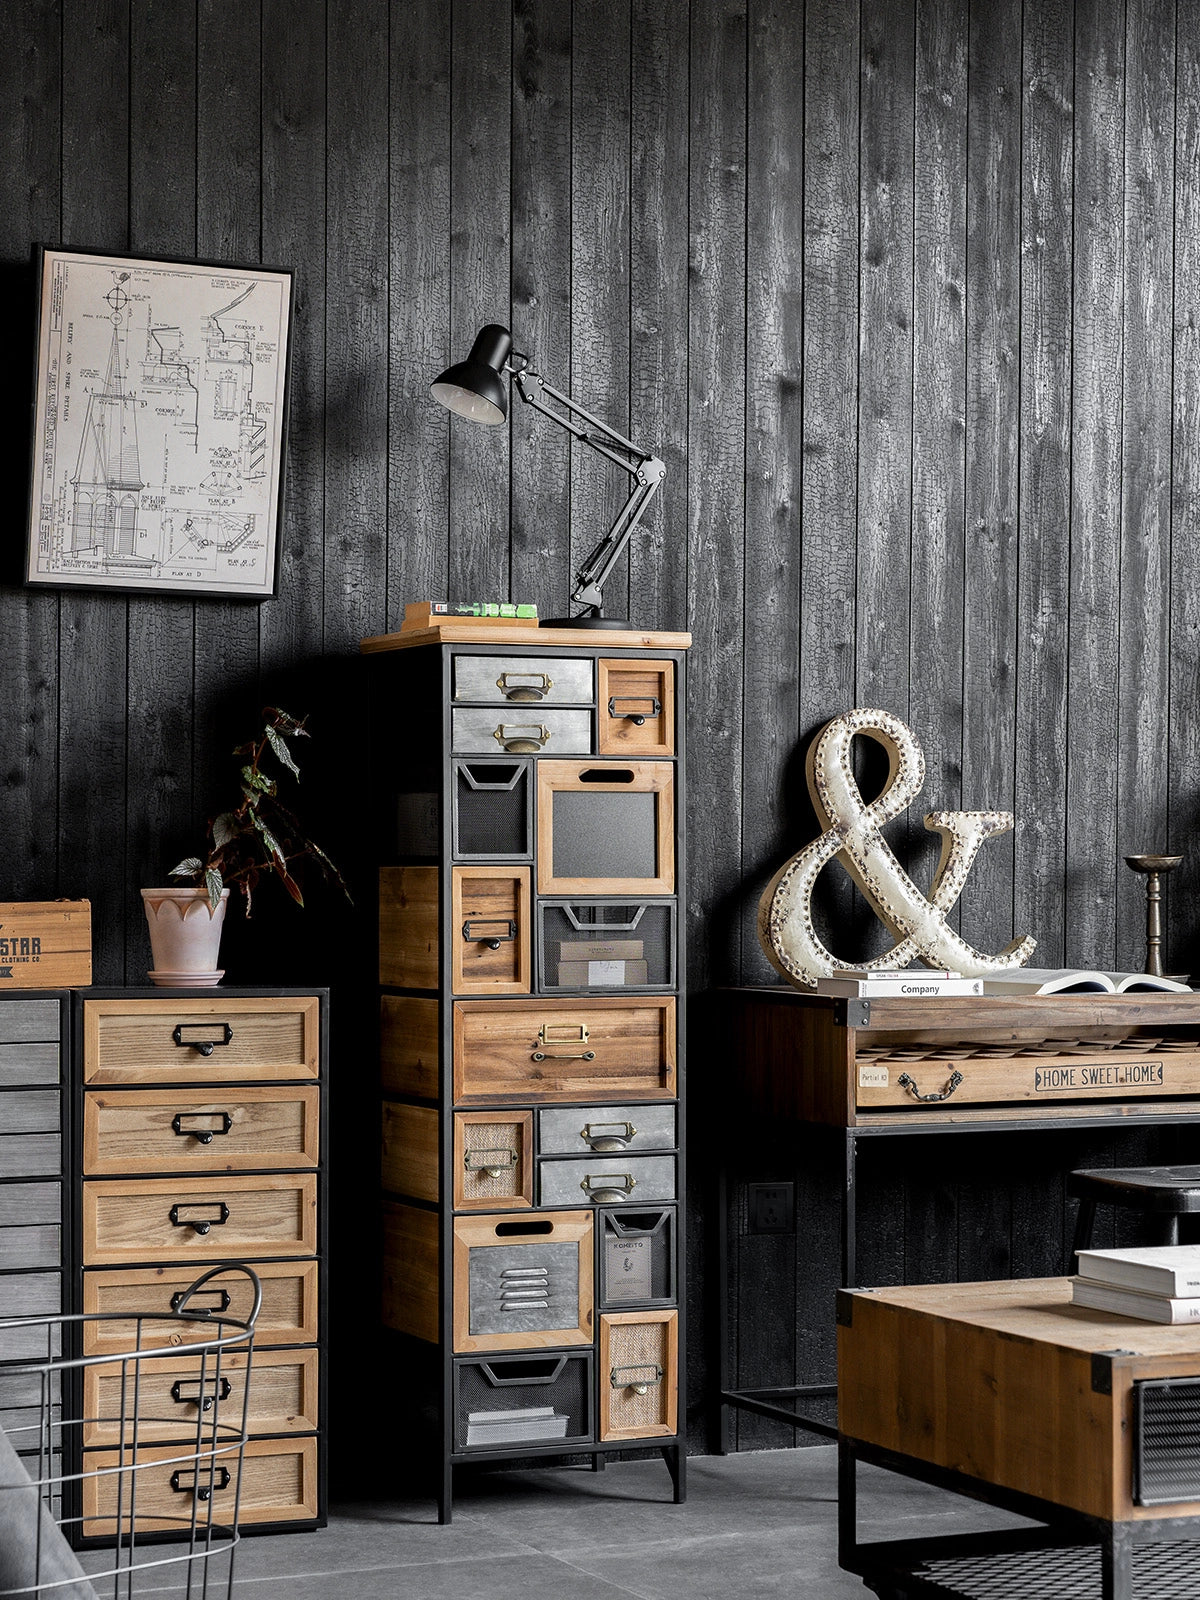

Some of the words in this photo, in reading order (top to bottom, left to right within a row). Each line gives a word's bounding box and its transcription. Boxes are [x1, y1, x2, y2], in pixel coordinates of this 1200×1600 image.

[1, 956, 30, 964] CLOTHING
[901, 984, 940, 995] Company
[1043, 1069, 1076, 1087] HOME
[1081, 1067, 1119, 1085] SWEET
[1125, 1065, 1156, 1083] HOME
